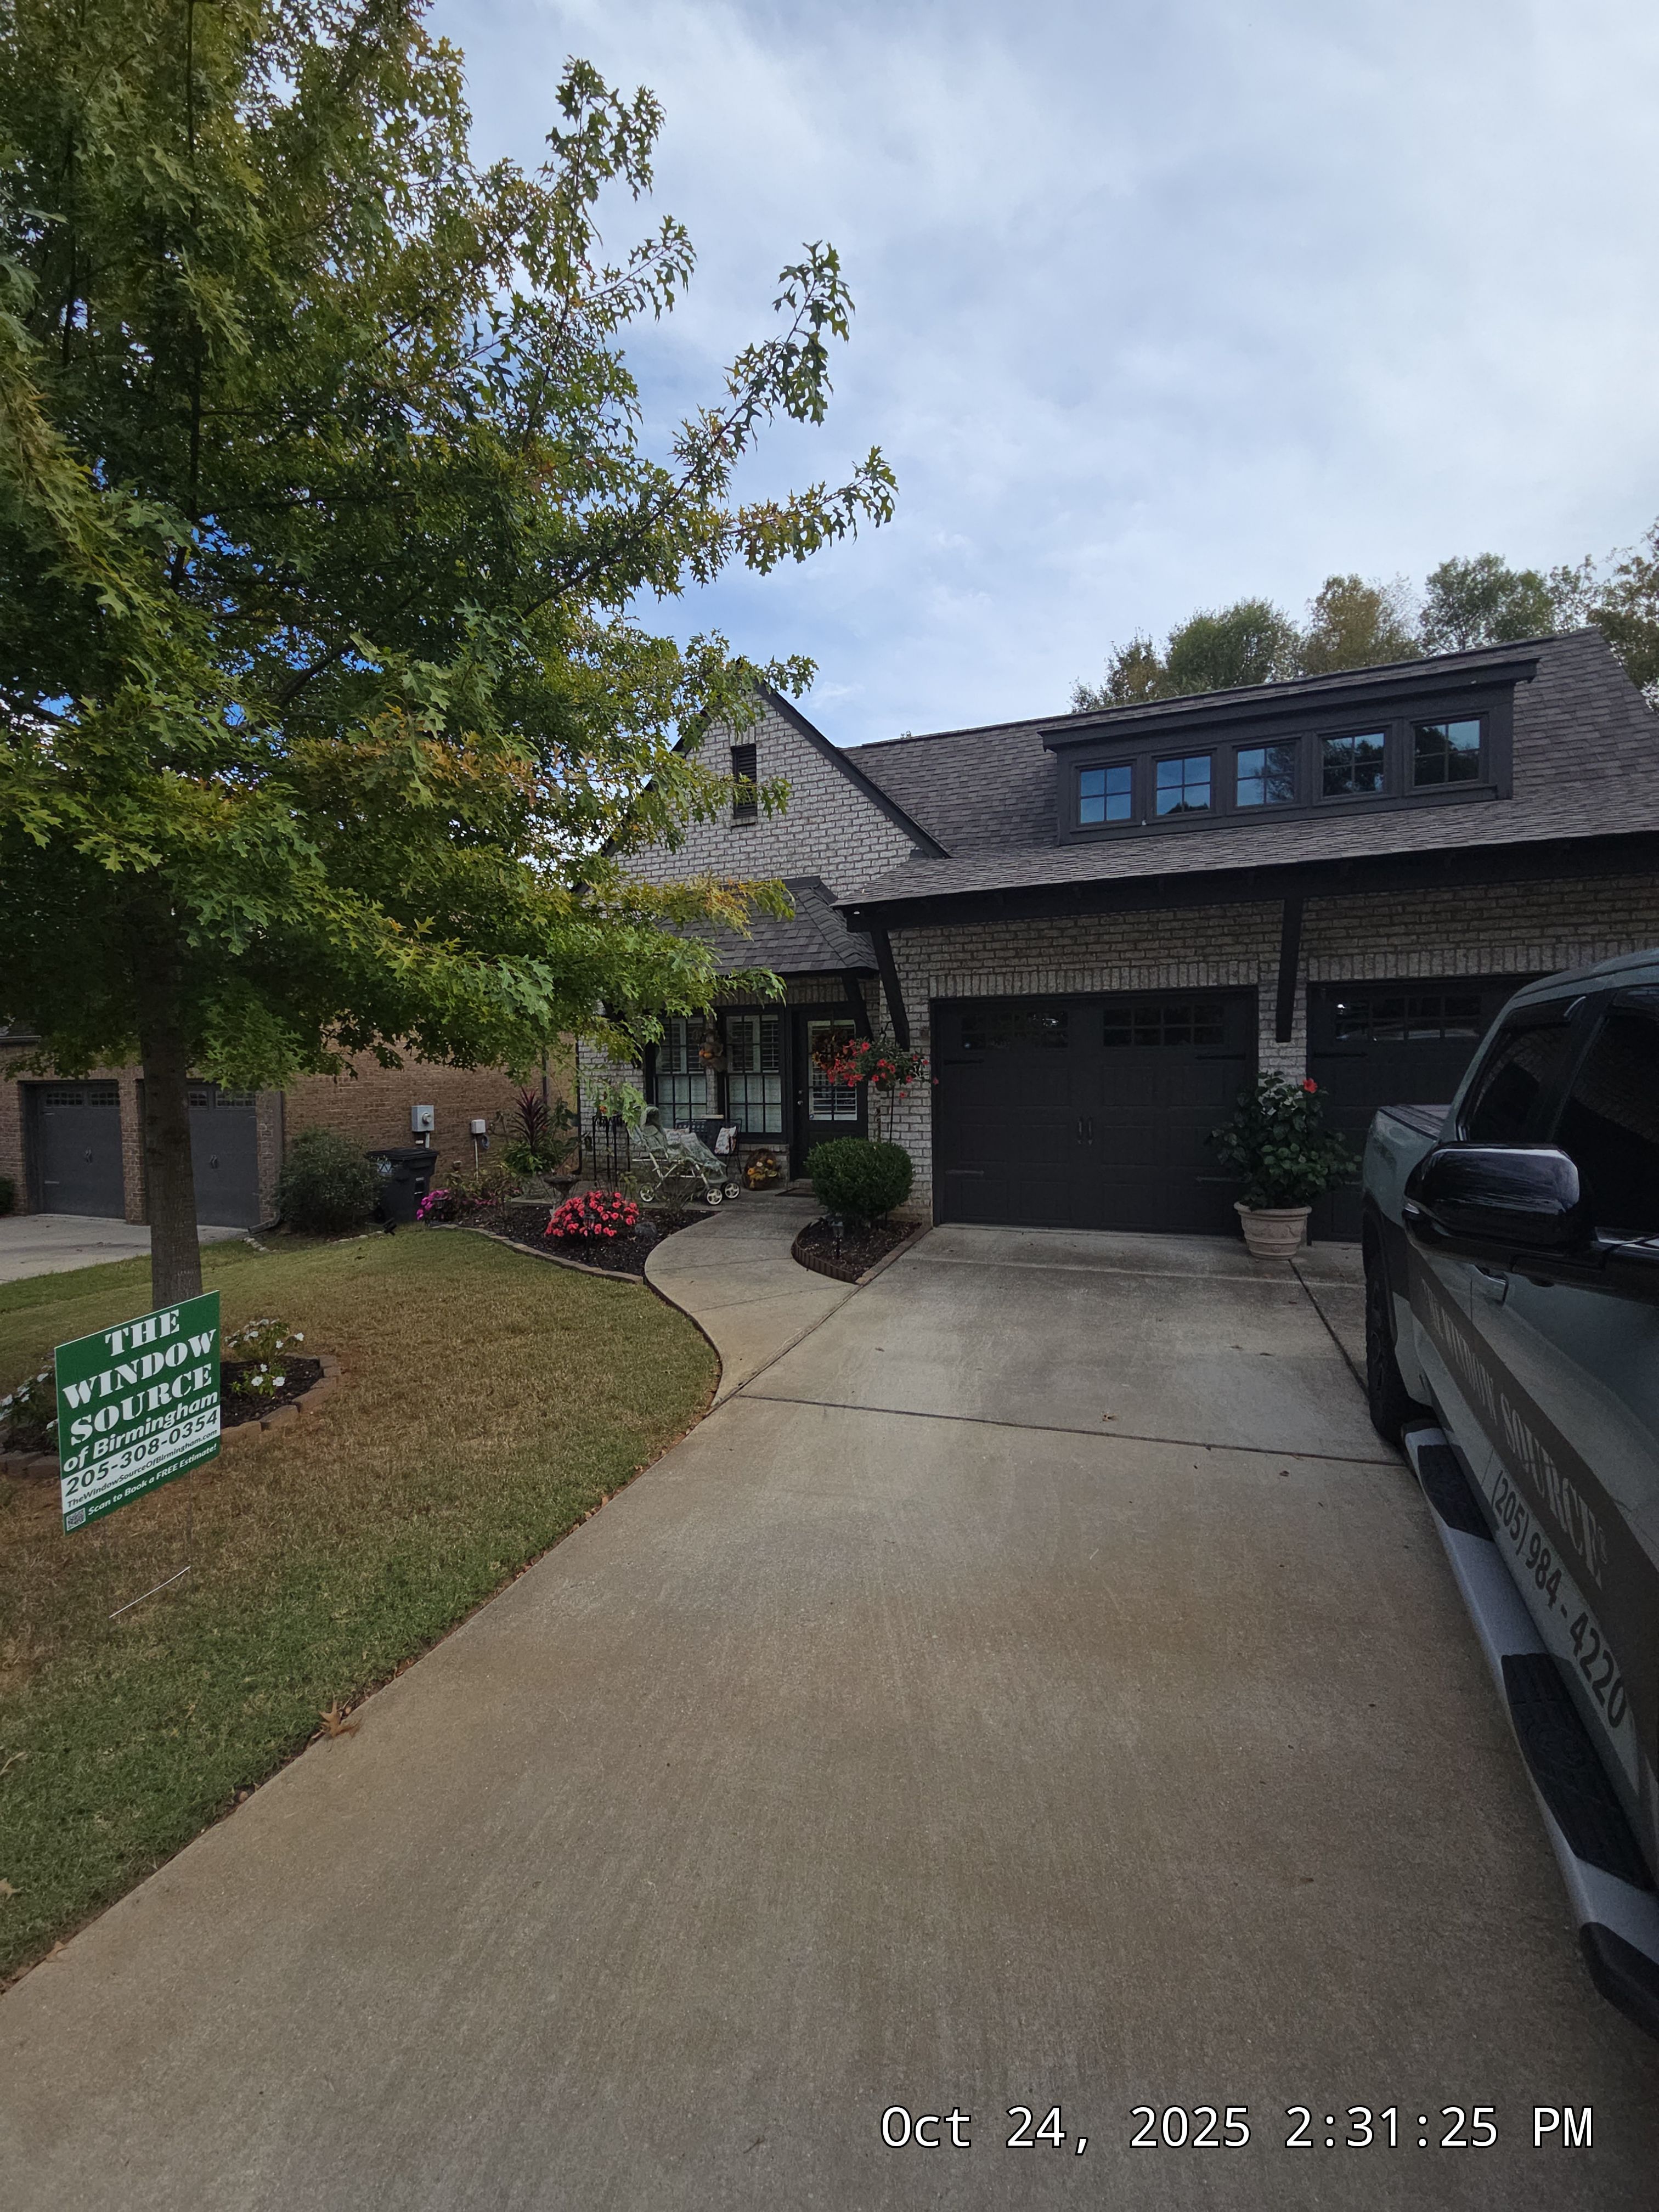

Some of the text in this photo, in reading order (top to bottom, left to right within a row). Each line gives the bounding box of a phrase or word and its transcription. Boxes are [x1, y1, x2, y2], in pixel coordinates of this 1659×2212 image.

[62, 1329, 217, 1409] WINDOW
[105, 1309, 180, 1357] THE
[63, 1392, 218, 1472] of Birmingham
[71, 1363, 212, 1446] SOURCE
[65, 1409, 217, 1497] 205-308-0354
[67, 1430, 217, 1508] TheWindowSourceOfBirmingham.com
[88, 1498, 111, 1515] Scan
[113, 1491, 122, 1502] to
[125, 1480, 147, 1497] Book
[156, 1465, 178, 1480] FREE
[179, 1443, 217, 1468] Estimate!
[1492, 1470, 1529, 1555] (205)
